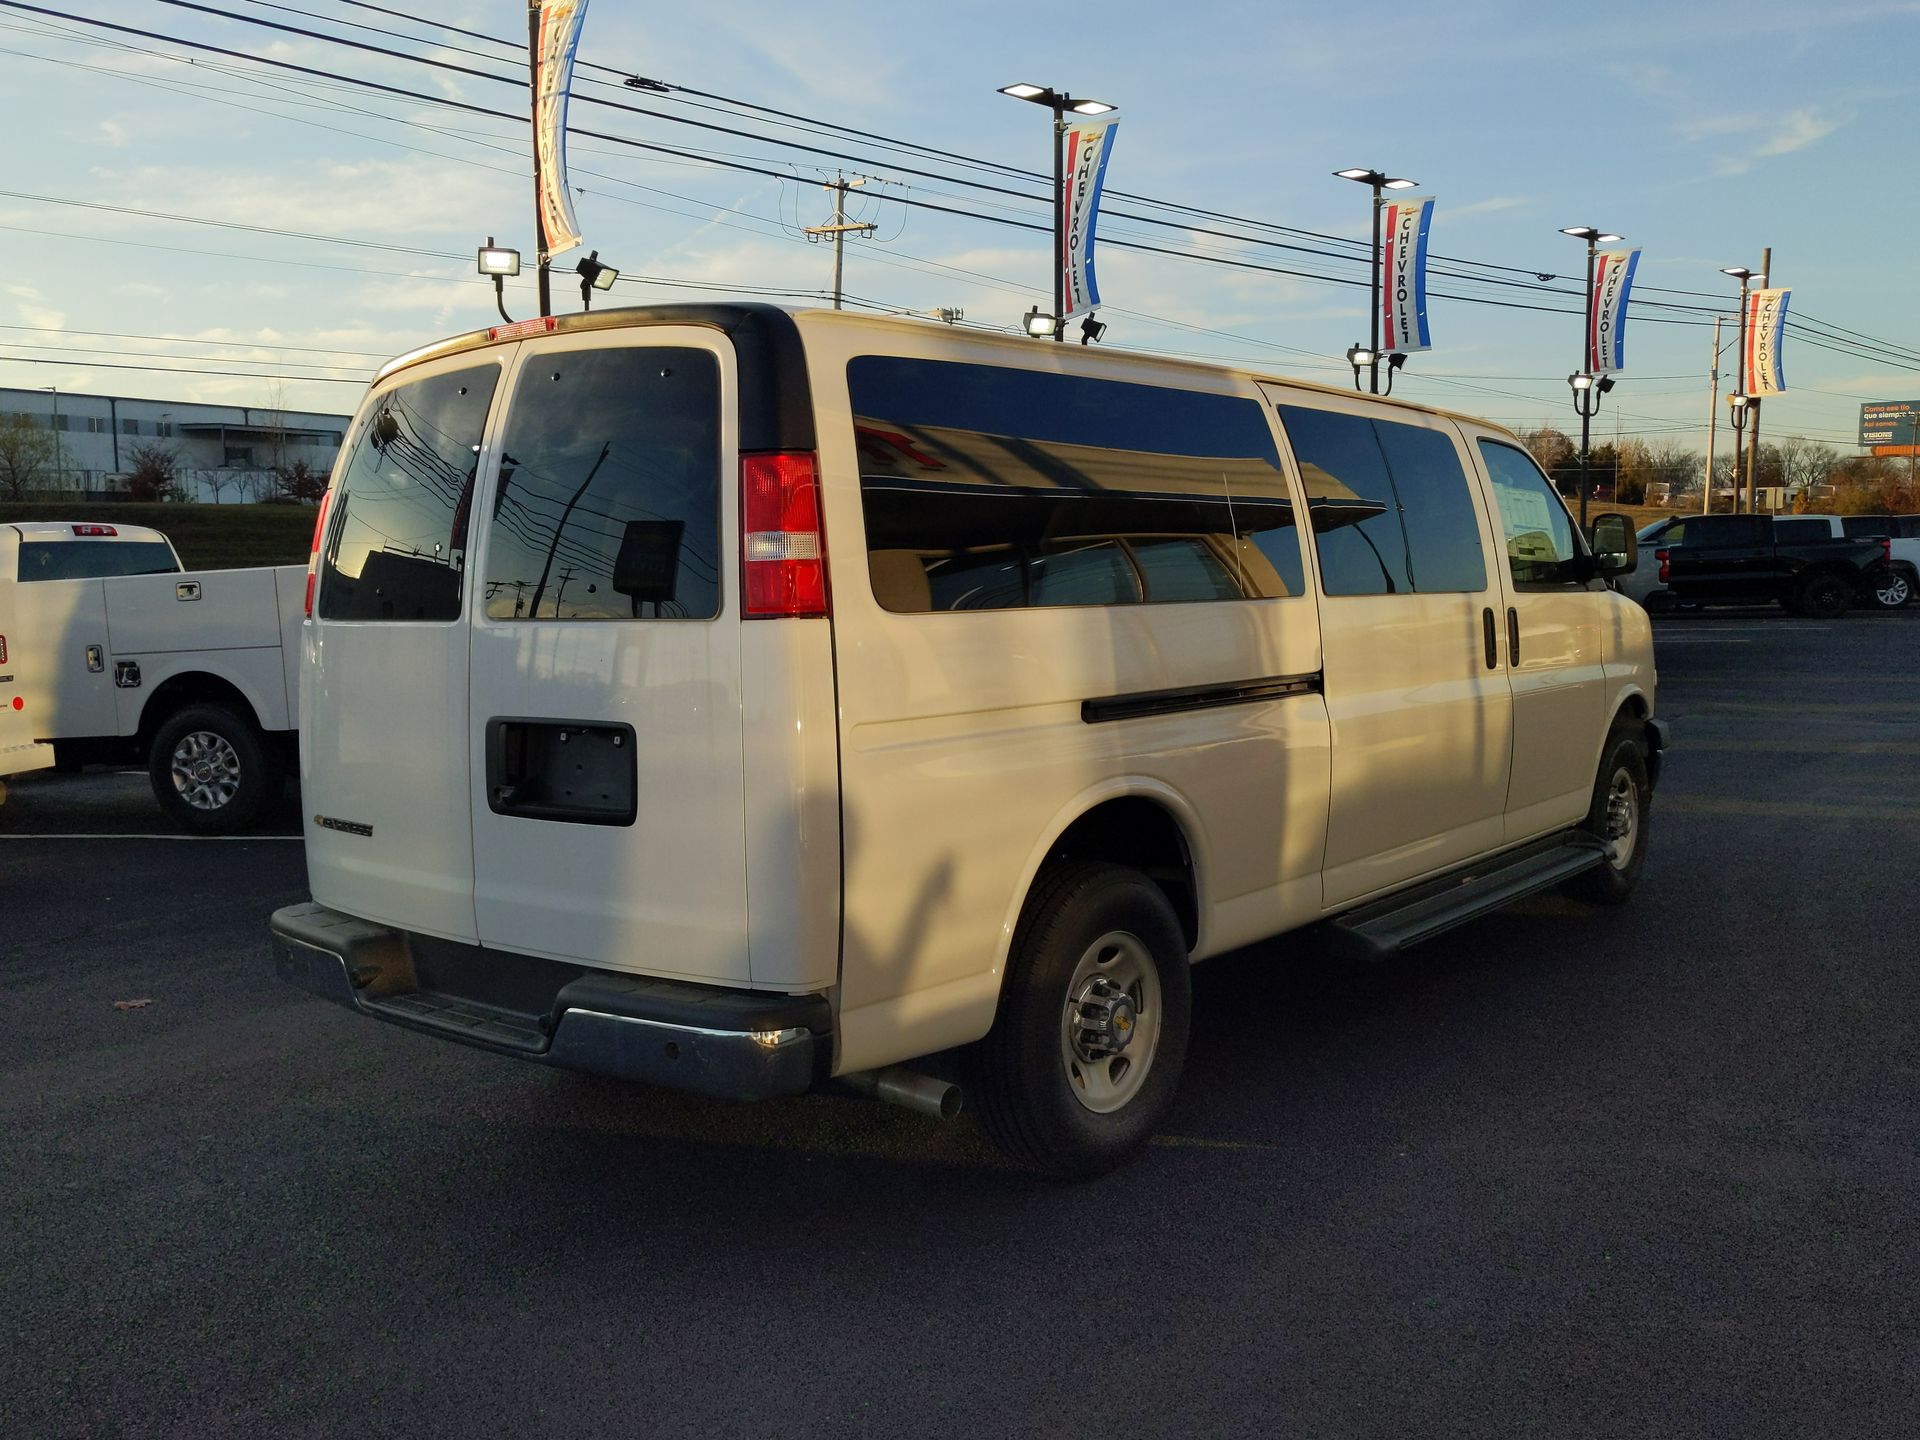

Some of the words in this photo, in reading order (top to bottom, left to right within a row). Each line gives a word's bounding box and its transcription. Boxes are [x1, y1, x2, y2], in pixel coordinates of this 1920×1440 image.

[1069, 146, 1093, 304] CHEVROLET
[1396, 217, 1411, 344] CHEVROLET
[1600, 264, 1620, 368] CHEVROLET
[1758, 303, 1773, 390] CHEVROLET
[1878, 411, 1907, 419] siempre
